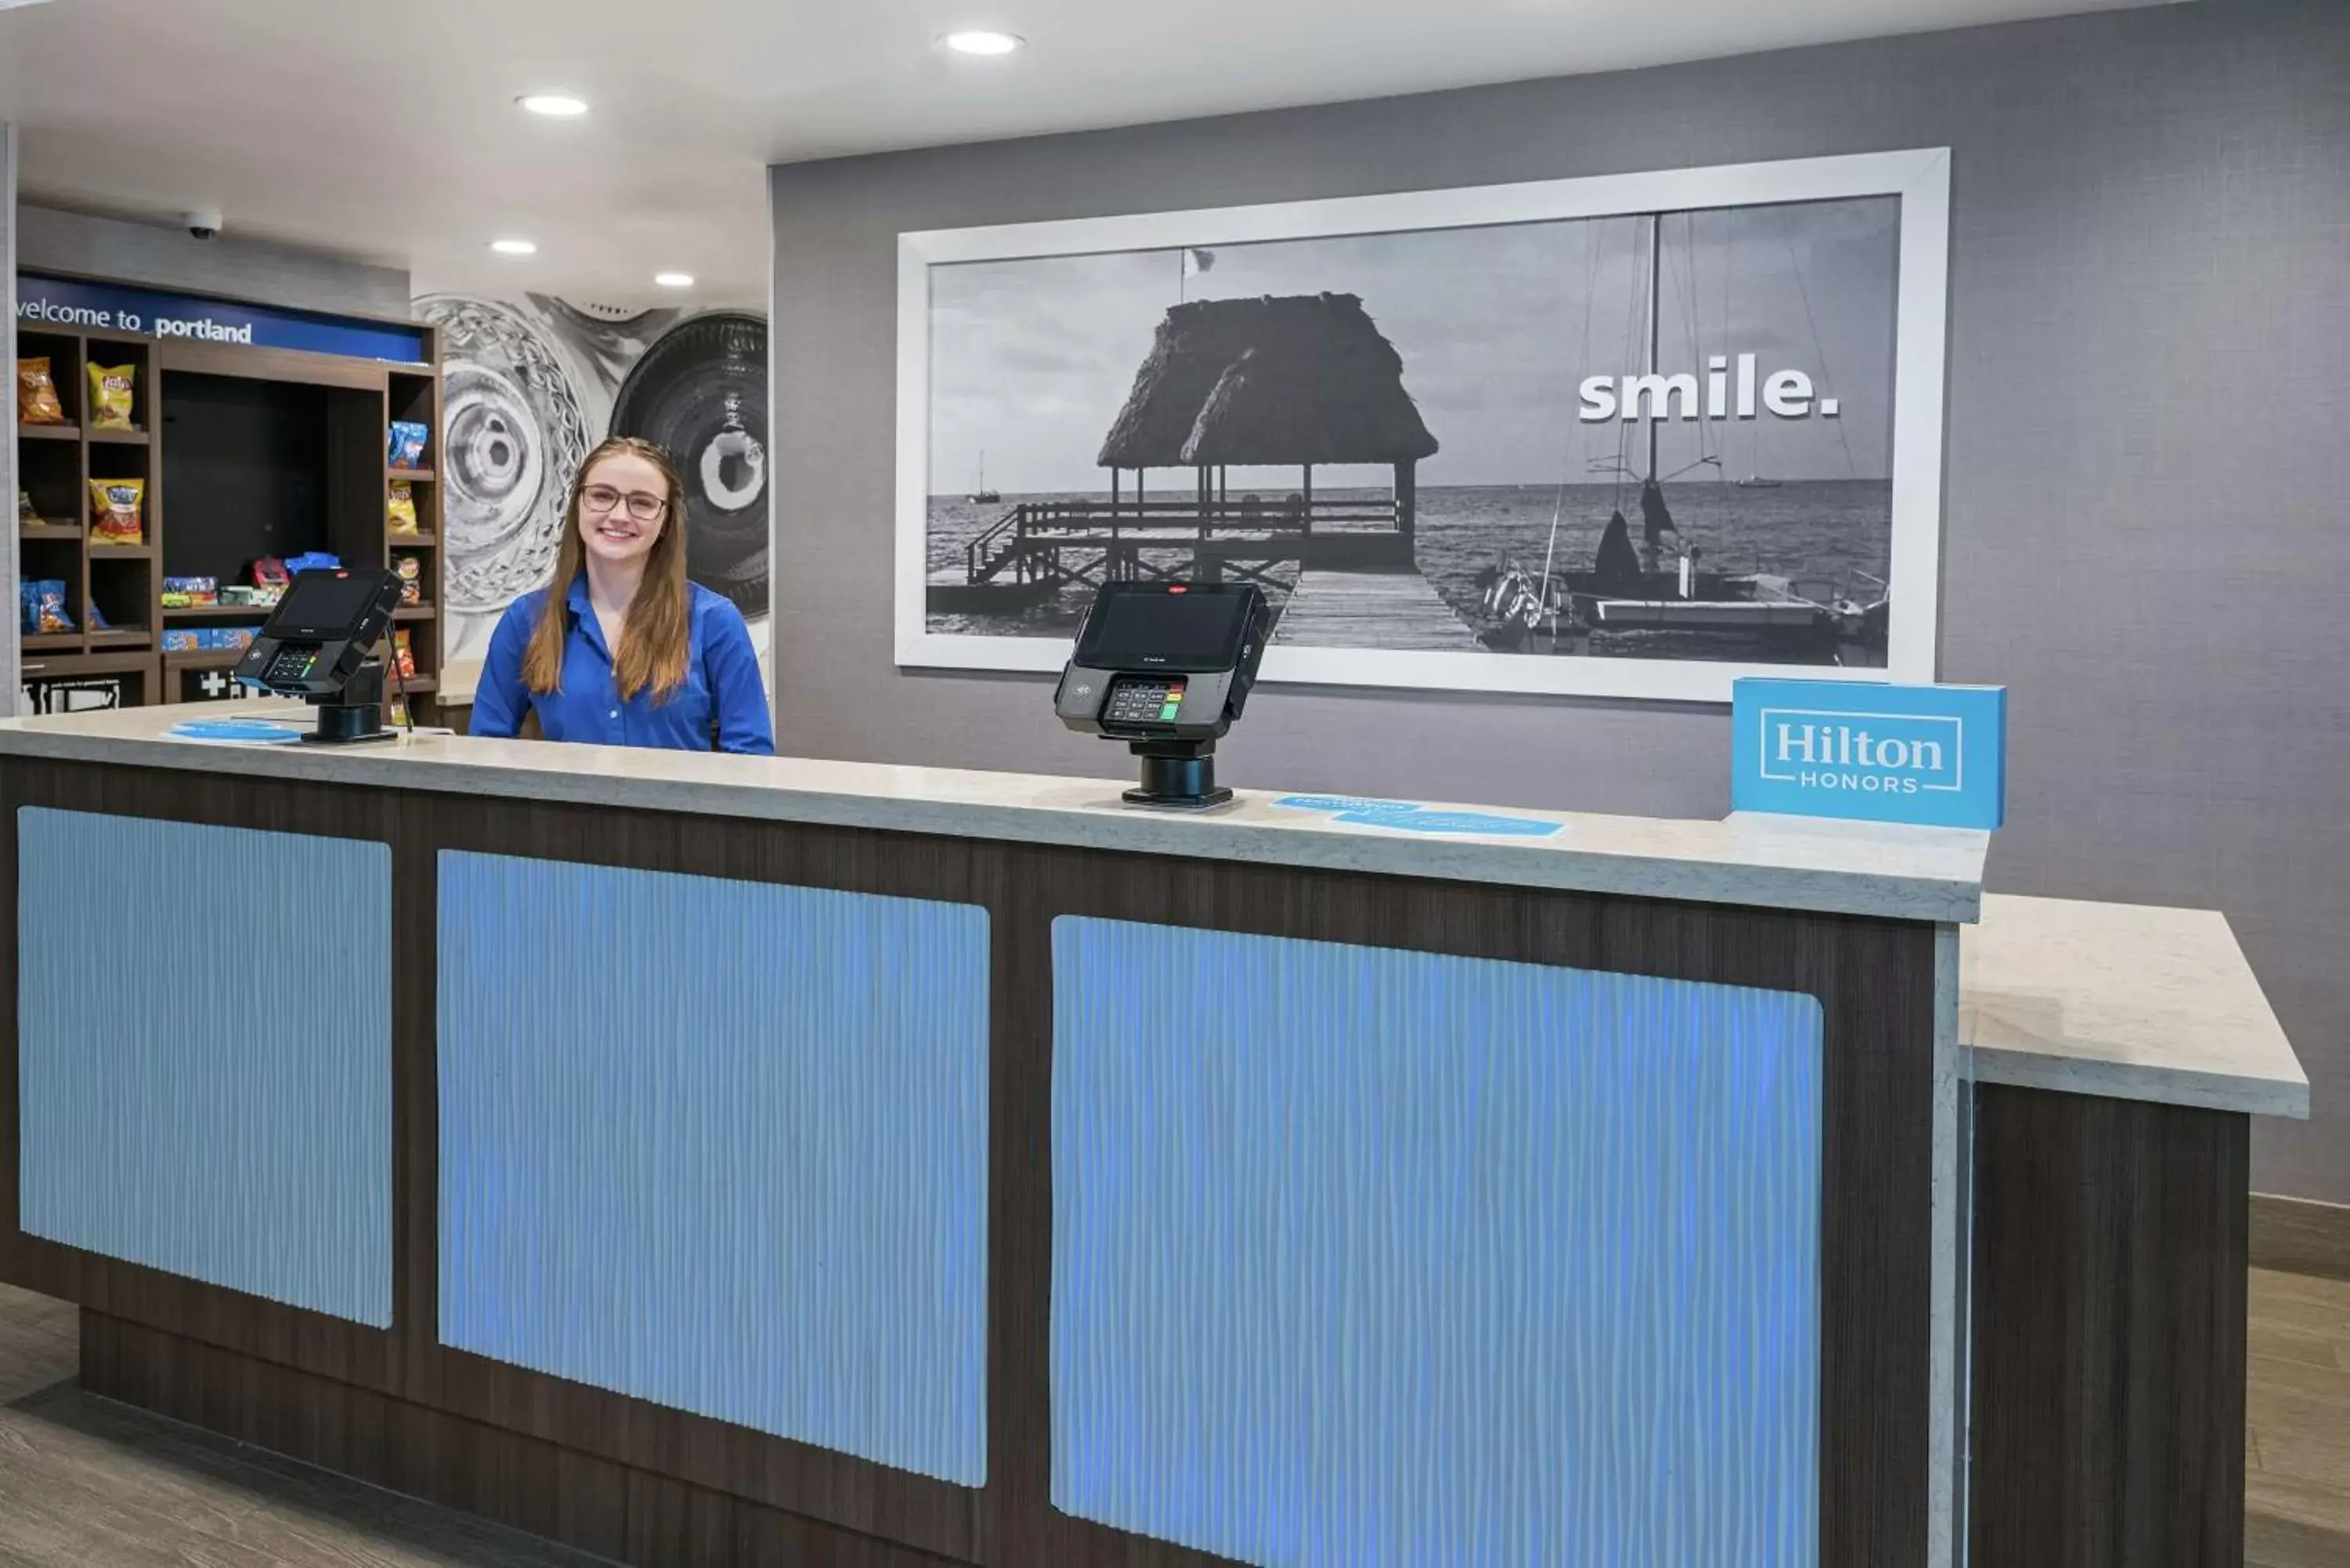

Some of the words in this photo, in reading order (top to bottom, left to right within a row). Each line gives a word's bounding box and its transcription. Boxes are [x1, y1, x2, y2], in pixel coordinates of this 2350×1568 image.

[118, 309, 141, 331] to
[154, 317, 251, 344] portland
[1578, 353, 1839, 422] smile.
[1777, 724, 1943, 770] Hilton
[1801, 771, 1918, 794] HONORS
